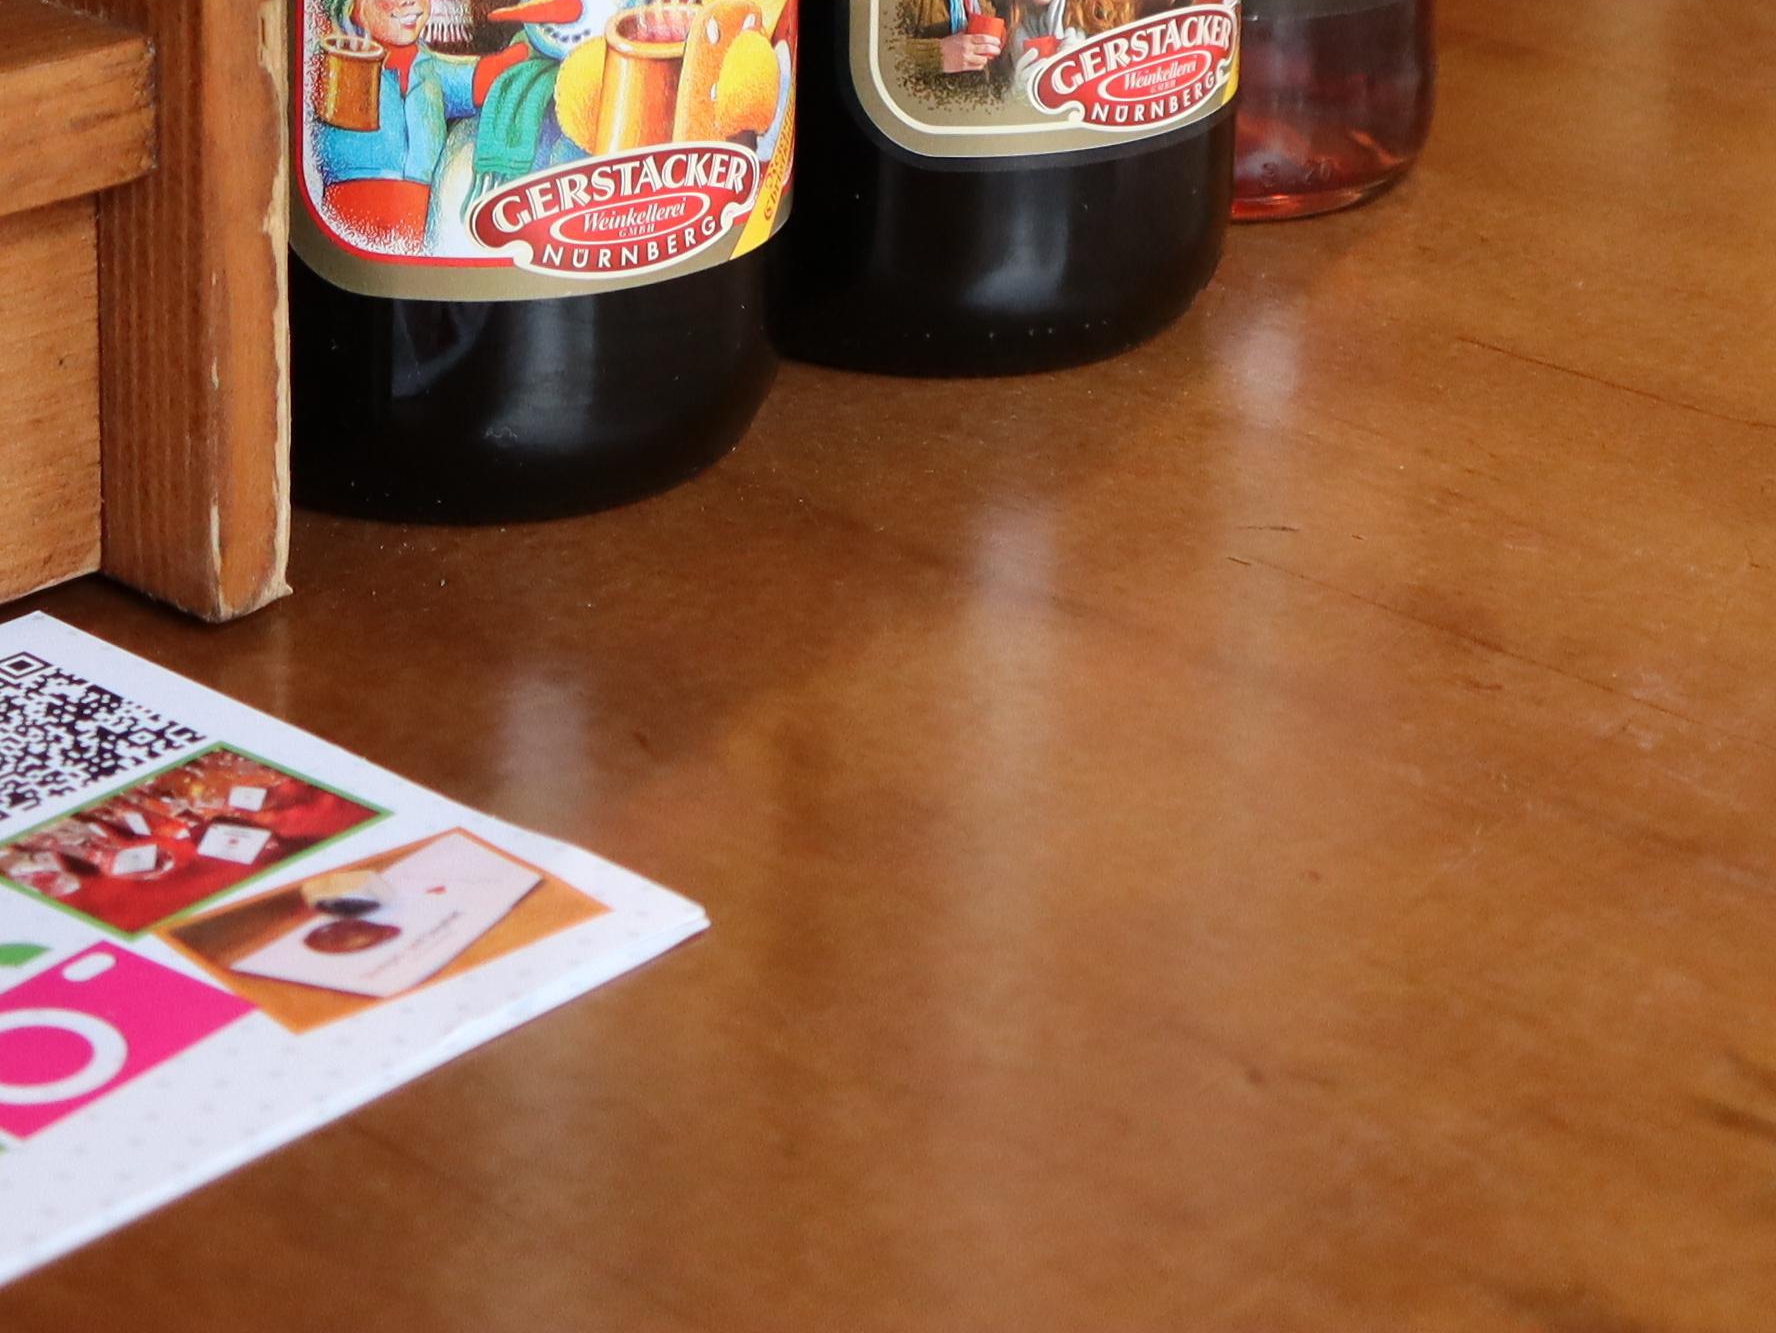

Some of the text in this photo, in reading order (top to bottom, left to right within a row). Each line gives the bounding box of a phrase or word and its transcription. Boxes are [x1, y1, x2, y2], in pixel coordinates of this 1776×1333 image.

[1052, 16, 1231, 95] GERSTACKER
[1124, 56, 1197, 91] Weinkellerei
[1091, 74, 1216, 123] NÜRNBERG
[492, 153, 748, 233] GERSTACKER
[582, 197, 687, 232] Weinkellerei
[542, 215, 716, 268] NÜRNBERG
